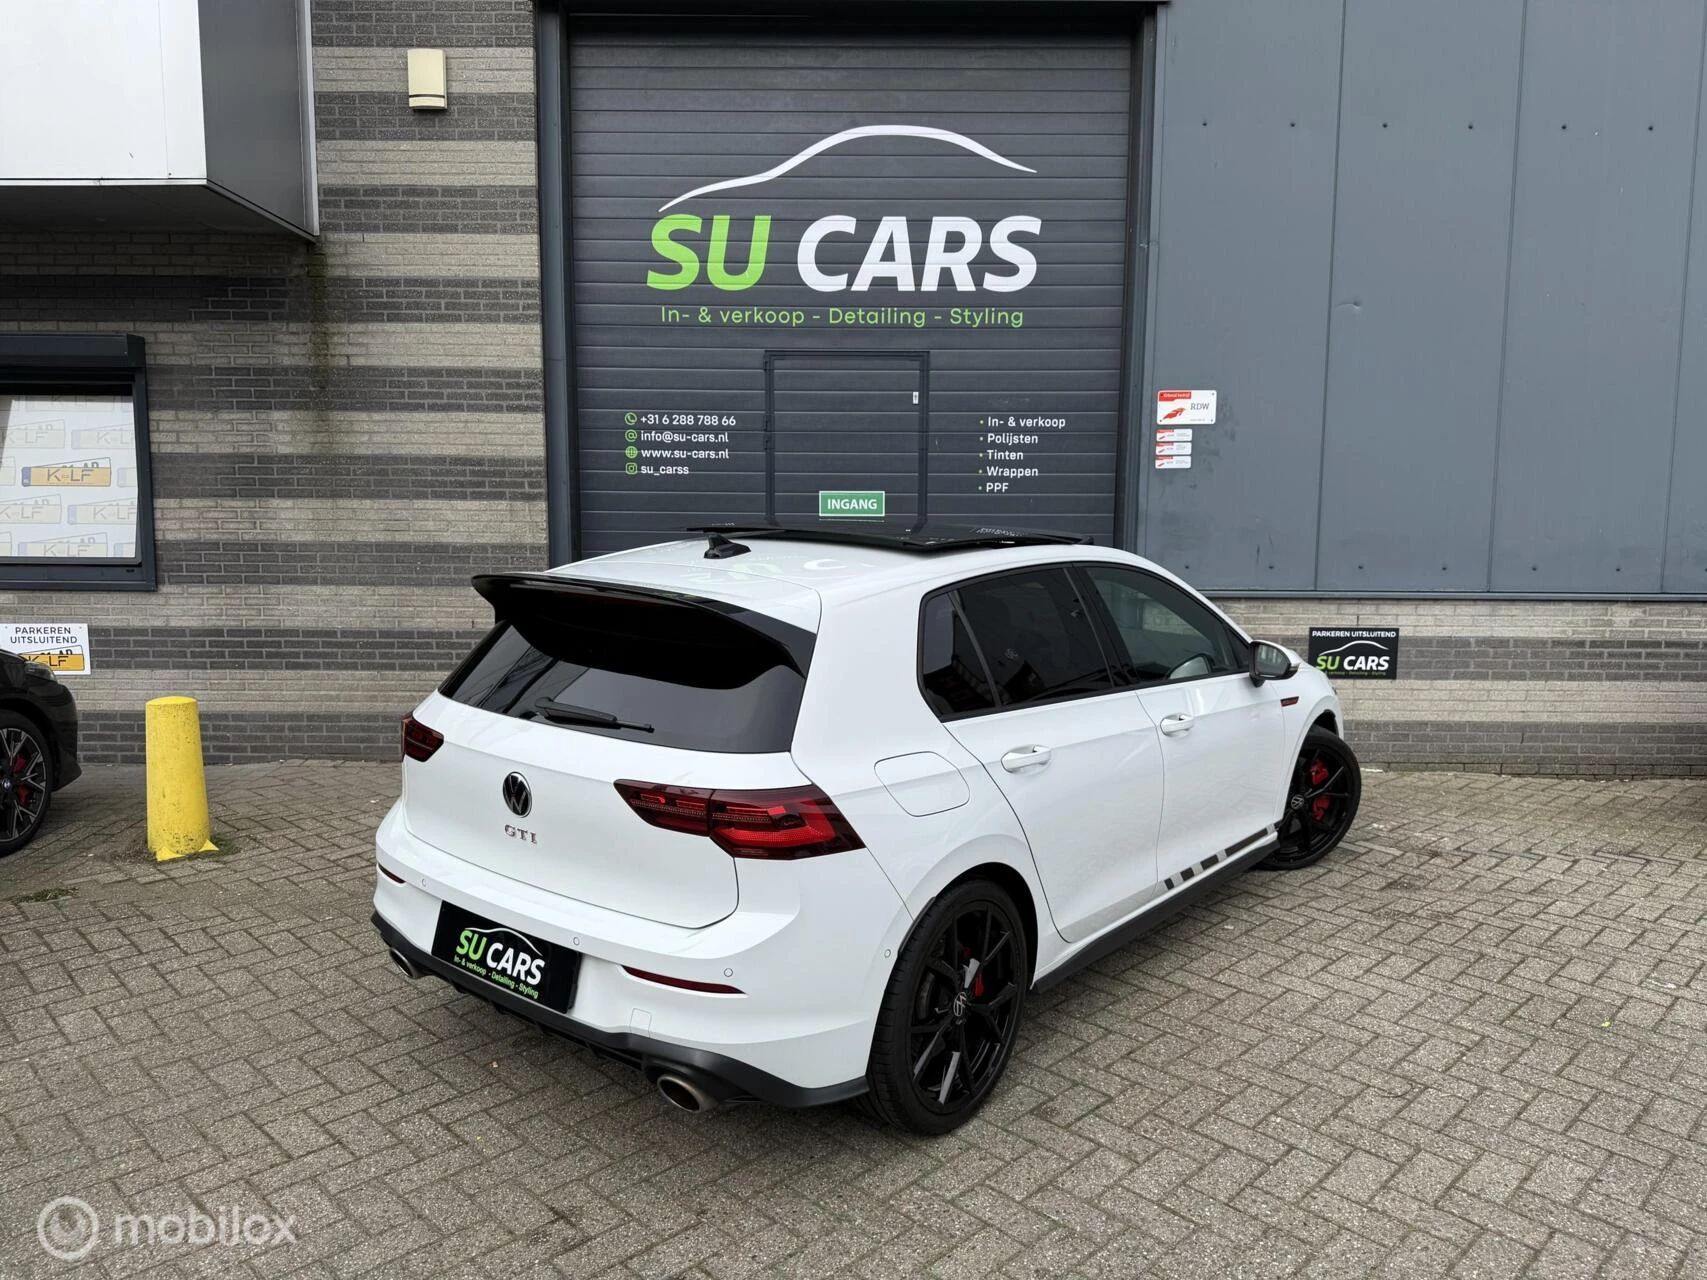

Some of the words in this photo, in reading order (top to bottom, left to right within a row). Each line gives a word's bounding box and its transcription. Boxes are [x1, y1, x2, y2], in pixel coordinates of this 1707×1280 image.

[646, 213, 772, 291] SU
[796, 214, 1042, 293] CARS
[661, 306, 691, 324] In-
[698, 307, 711, 324] &
[719, 307, 805, 327] verkoop
[829, 307, 926, 328] Detailing
[949, 307, 1024, 328] Styling
[1190, 402, 1210, 411] RDW
[640, 414, 659, 425] +31
[662, 414, 670, 425] 6
[672, 414, 695, 426] 288
[697, 414, 719, 426] 788
[721, 415, 737, 426] 66
[987, 416, 1005, 427] In-
[1007, 416, 1016, 427] &
[1019, 416, 1066, 430] verkoop
[640, 430, 729, 443] info@su-cars.nl
[987, 432, 1039, 446] Polijsten
[640, 448, 730, 459] www.su-cars.nl
[986, 449, 1024, 461] Tinten
[640, 464, 690, 476] su_carss
[986, 466, 1039, 479] Wrappen
[986, 482, 1009, 493] PPF
[827, 498, 878, 510] INGANG
[15, 626, 71, 635] PARKEREN
[1352, 630, 1396, 638] UITSLUITEND
[10, 636, 77, 644] UITSLUITEND
[1316, 655, 1341, 670] SU
[1343, 655, 1390, 671] CARS
[504, 824, 538, 845] GTI
[456, 930, 487, 960] SU
[486, 942, 545, 985] CARS
[466, 961, 487, 976] verkoop
[491, 971, 516, 989] Detailing
[519, 982, 539, 999] Styling
